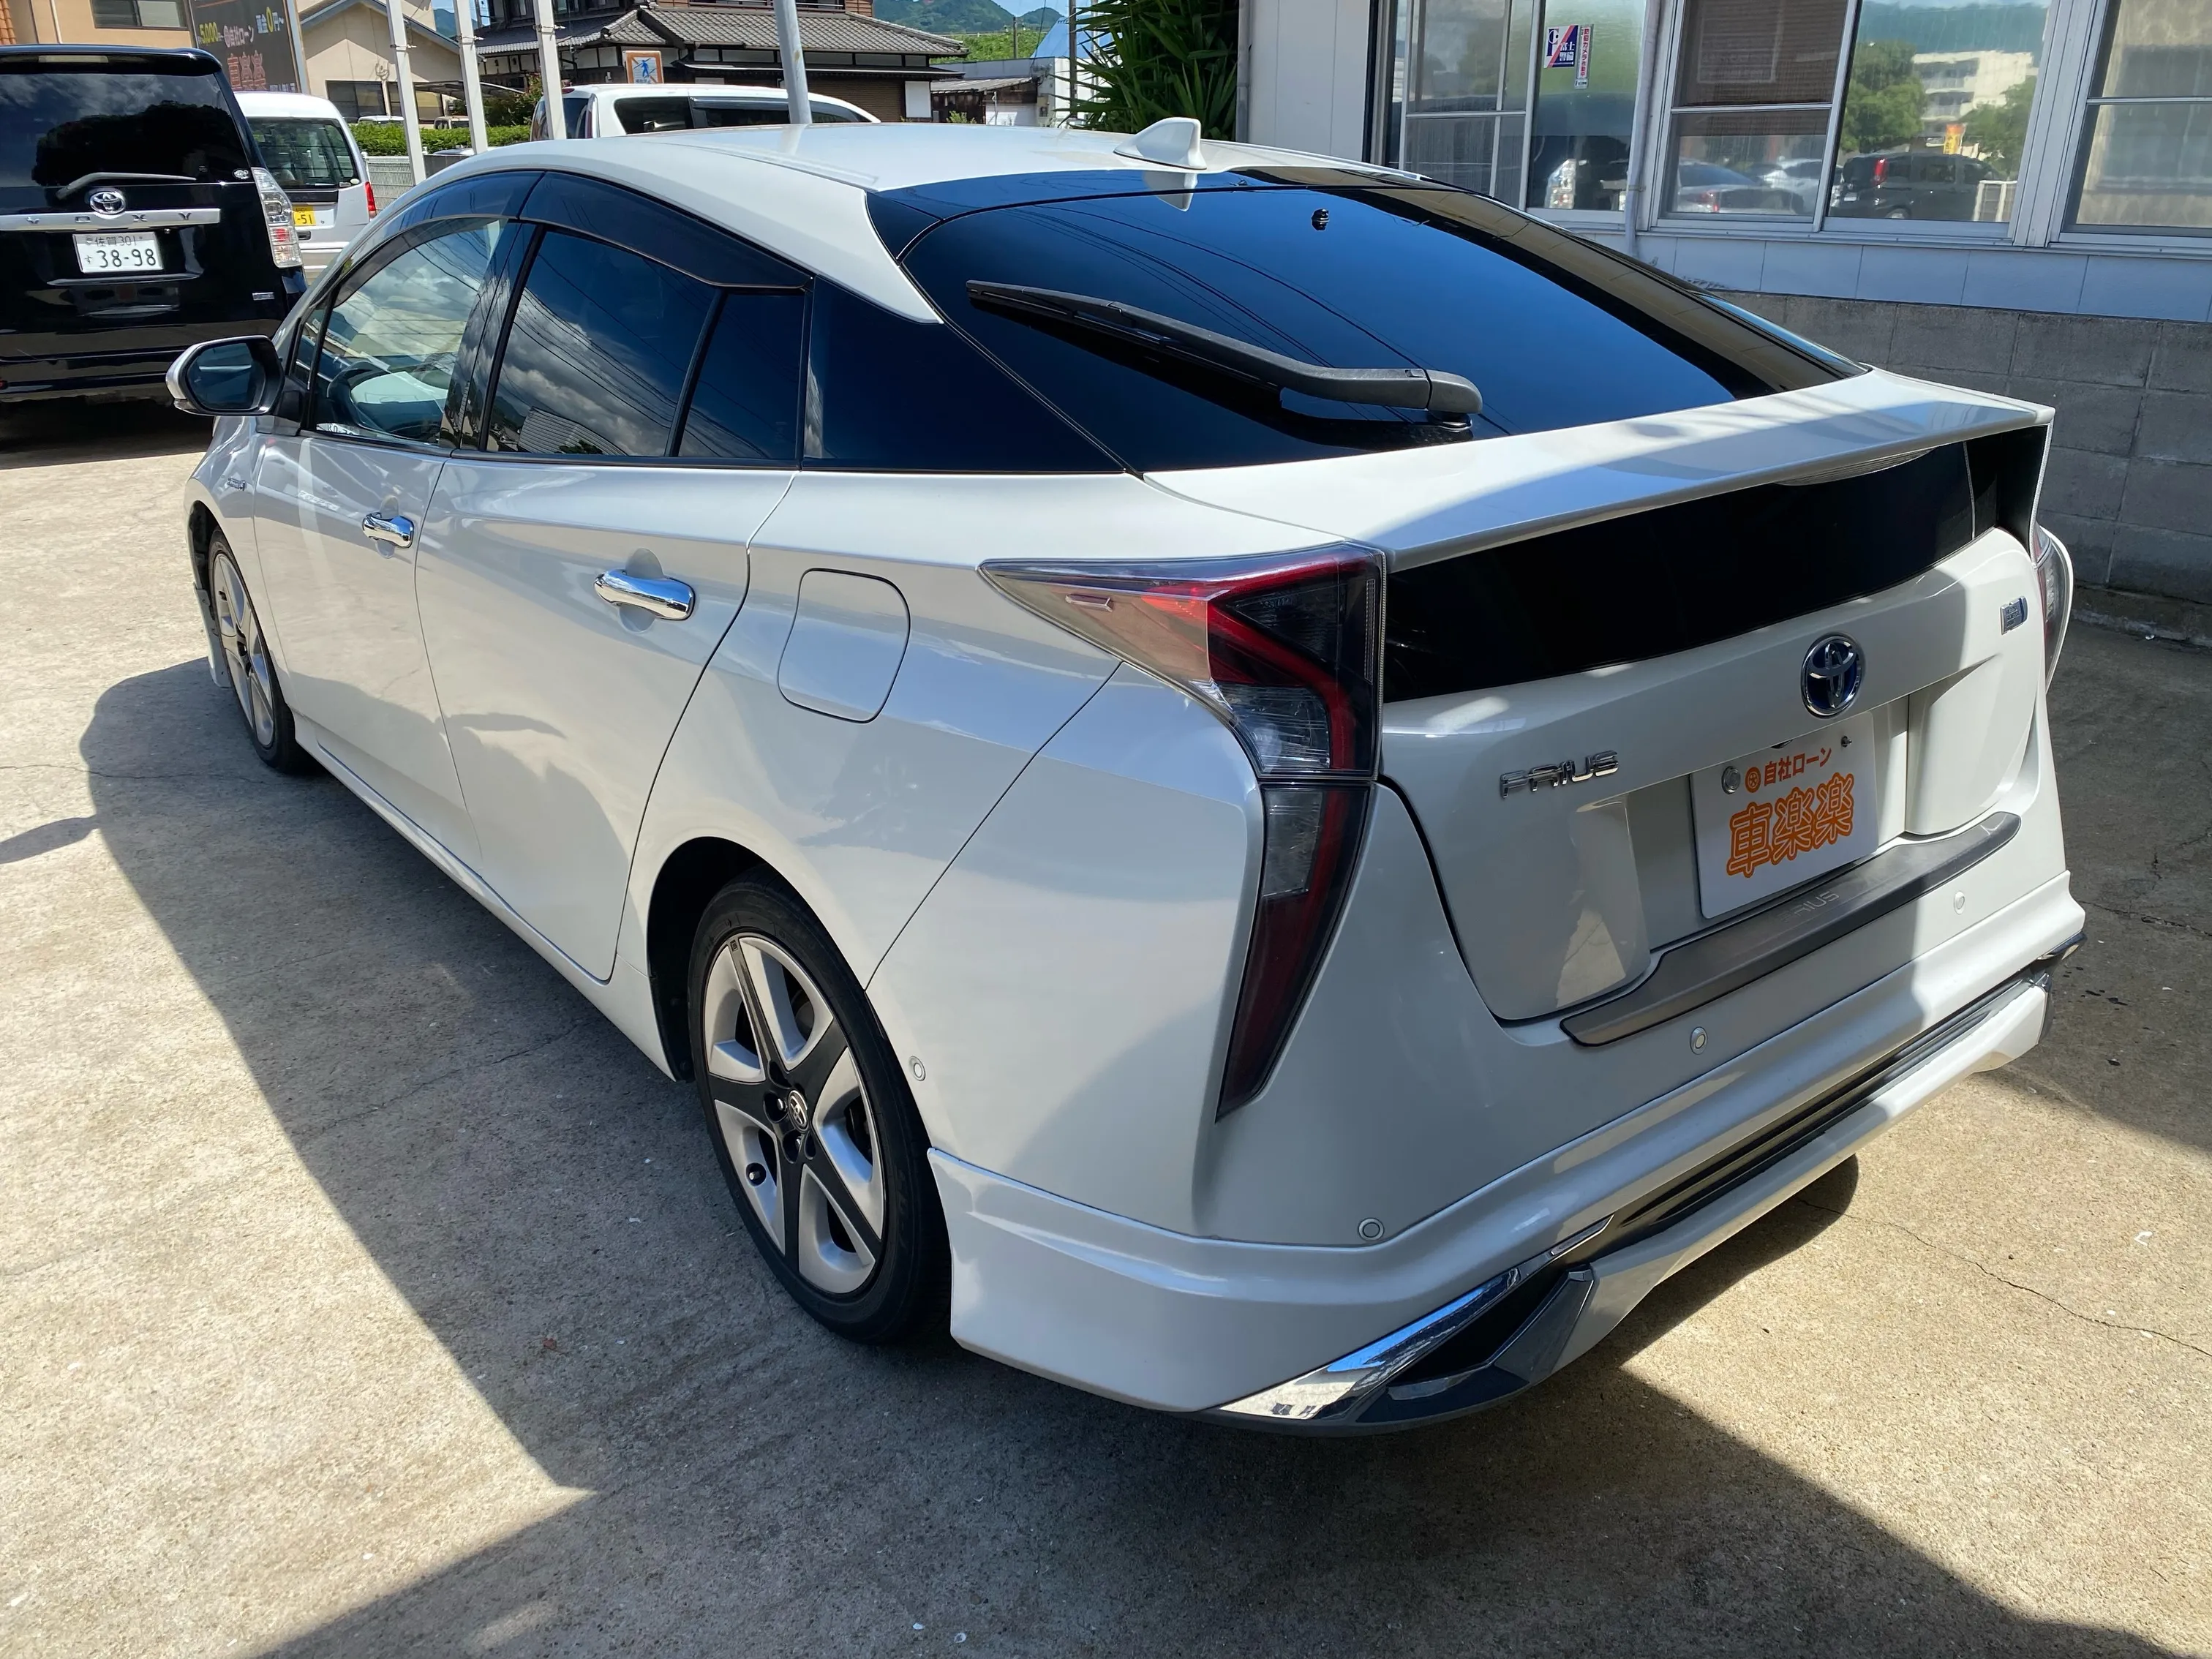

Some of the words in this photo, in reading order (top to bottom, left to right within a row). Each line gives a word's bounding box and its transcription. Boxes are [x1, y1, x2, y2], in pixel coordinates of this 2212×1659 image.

[96, 248, 157, 268] 38-98
[1500, 750, 1619, 798] PRIUS
[1764, 747, 1832, 787] 自社ローン
[1726, 772, 1854, 879] 車楽楽
